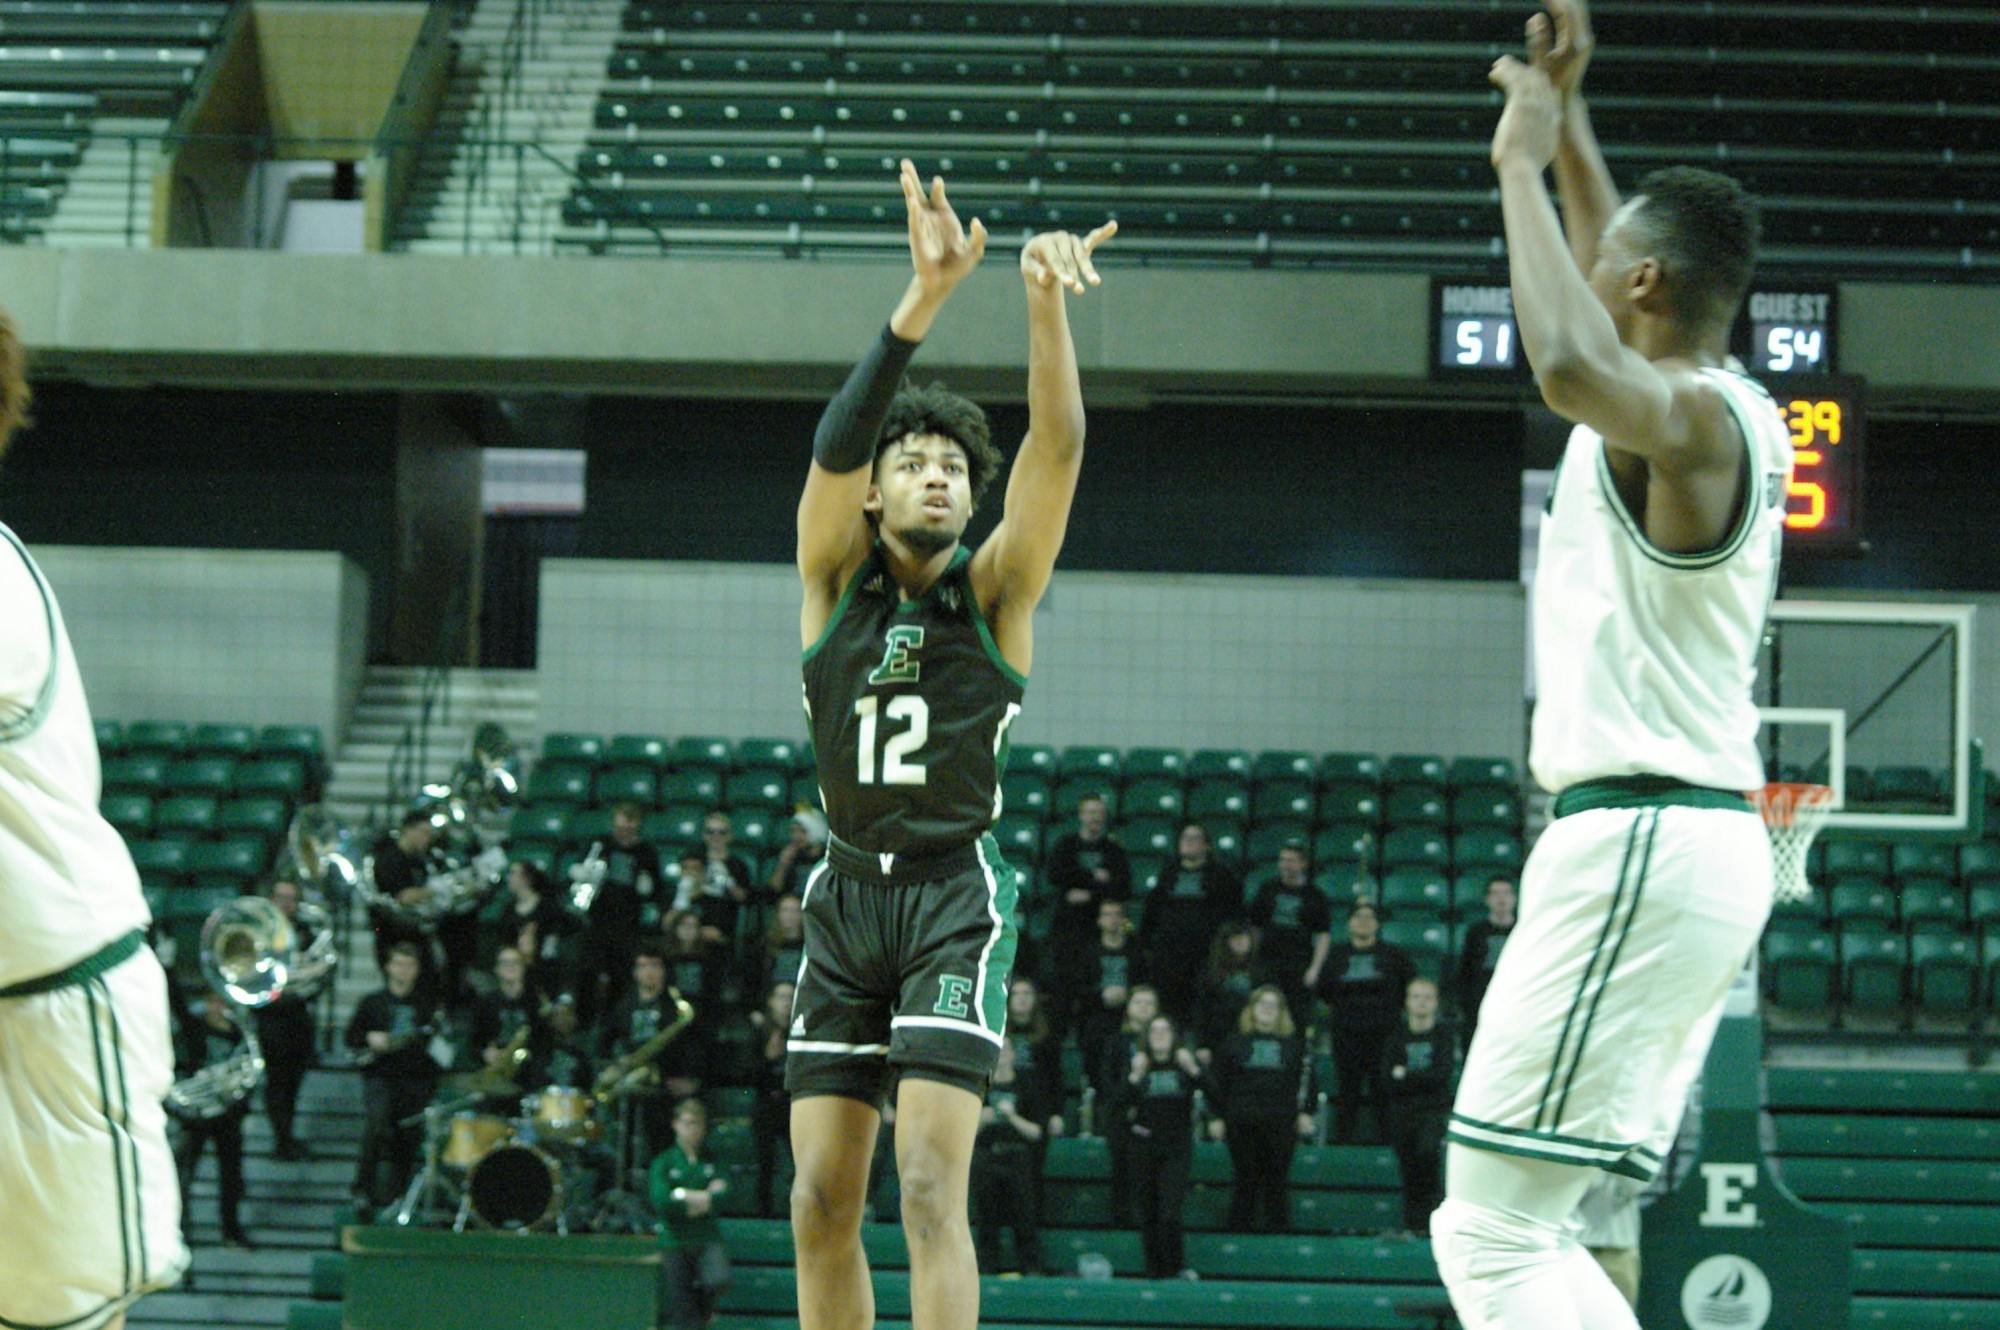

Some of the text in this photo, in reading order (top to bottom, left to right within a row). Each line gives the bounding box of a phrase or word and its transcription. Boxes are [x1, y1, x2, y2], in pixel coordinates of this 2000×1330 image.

[1750, 292, 1828, 320] GUEST
[1456, 321, 1510, 364] 51
[1767, 327, 1821, 371] 54
[868, 624, 924, 685] E
[855, 695, 928, 784] 12
[933, 974, 972, 1018] E
[1700, 1162, 1758, 1227] E
